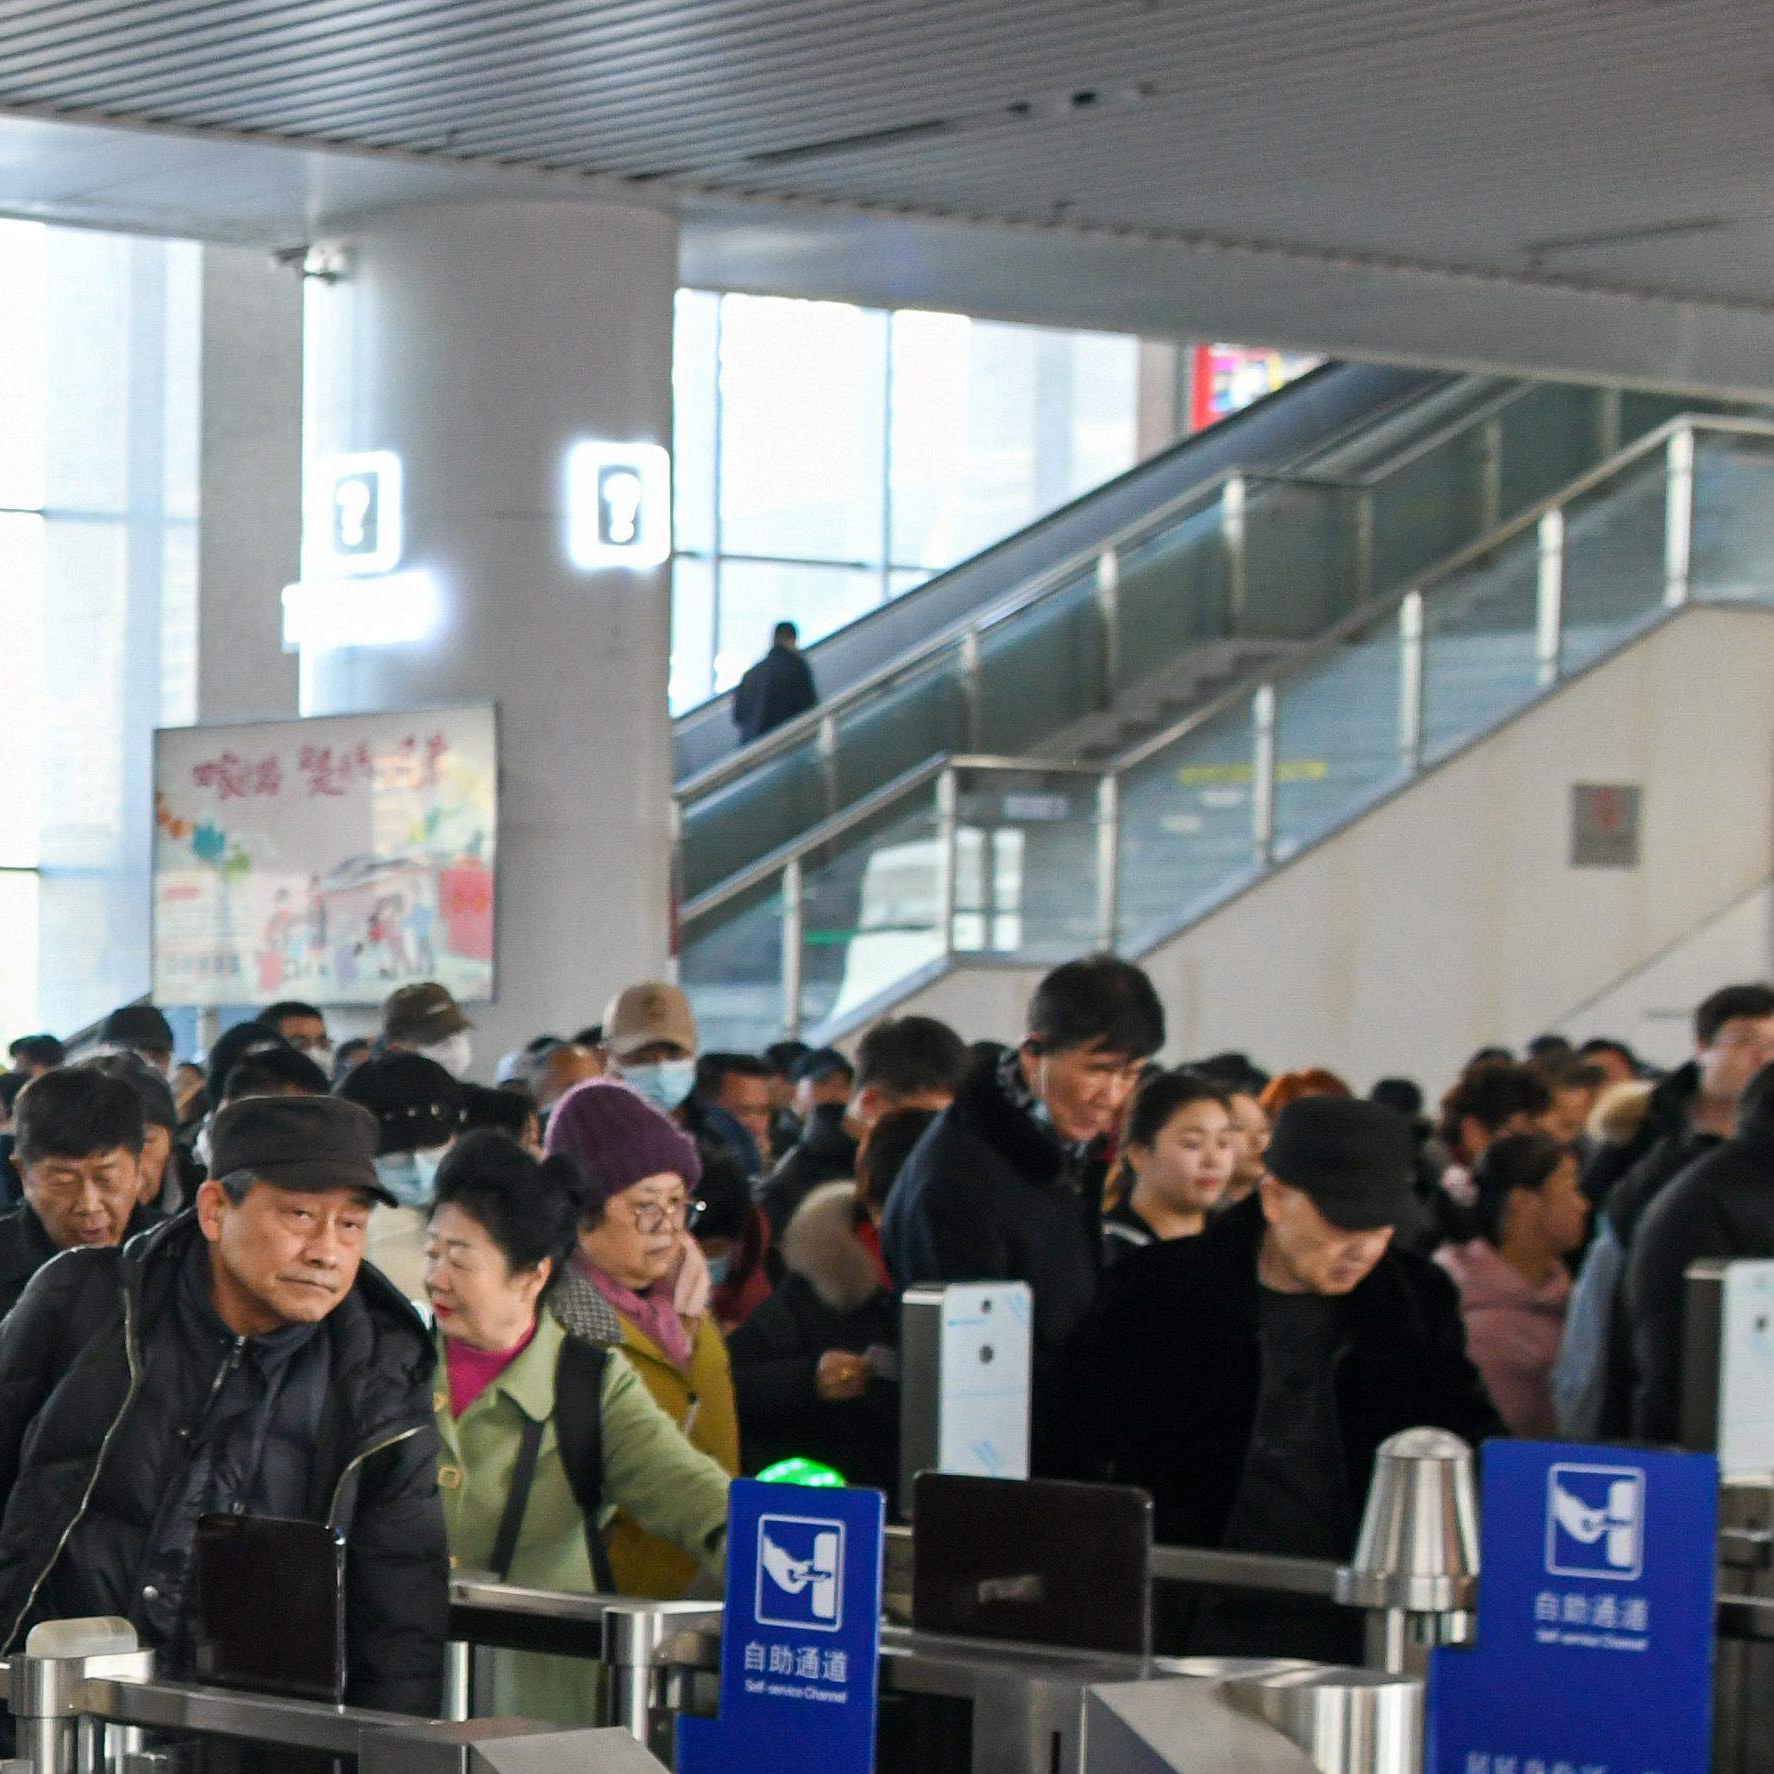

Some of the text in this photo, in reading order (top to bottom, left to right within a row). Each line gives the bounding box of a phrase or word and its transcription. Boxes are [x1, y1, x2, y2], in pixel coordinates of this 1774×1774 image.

[1536, 1590, 1648, 1632] 自助通道
[744, 1640, 848, 1684] 自助通道
